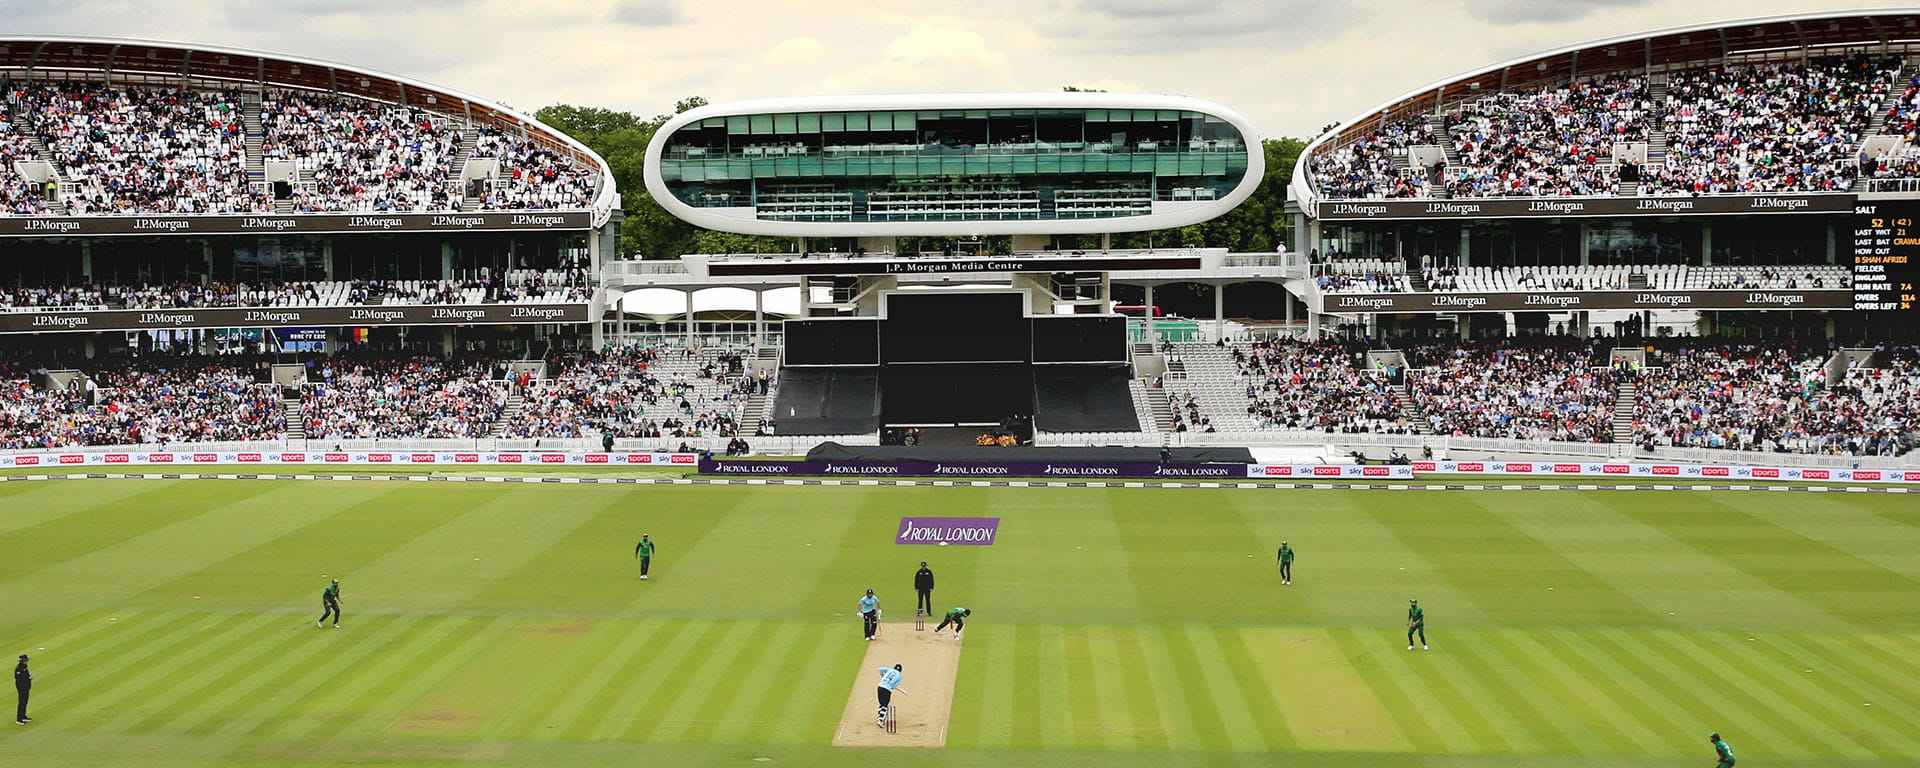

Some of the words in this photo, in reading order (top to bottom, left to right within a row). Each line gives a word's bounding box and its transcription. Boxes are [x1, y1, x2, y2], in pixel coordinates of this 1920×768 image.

[1529, 202, 1583, 213] J.P.Morgan
[1637, 200, 1693, 212] J.P.Morgan
[1751, 198, 1808, 210] J.P.Morgan
[1333, 205, 1386, 216] J.P.Morgan
[1426, 203, 1480, 215] J.P.Morgan
[1855, 206, 1876, 214] SALT
[134, 219, 189, 231] J.P.Morgan
[241, 218, 296, 230] J.P.Morgan
[349, 217, 402, 229] J.P.Morgan
[431, 216, 484, 228] J.P.Morgan
[511, 215, 564, 227] J.P.Morgan
[1872, 219, 1884, 227] 52
[25, 220, 79, 232] J.P.Morgan
[886, 264, 903, 272] J.P.
[907, 264, 947, 272] Morgan
[952, 262, 984, 270] Media
[988, 262, 1023, 270] Centre
[1339, 297, 1393, 309] J.P.Morgan
[1432, 296, 1486, 308] J.P.Morgan
[1525, 295, 1580, 307] J.P.Morgan
[1635, 294, 1691, 306] J.P.Morgan
[1746, 294, 1803, 305] J.P.Morgan
[245, 312, 299, 323] J.P.Morgan
[350, 310, 403, 321] J.P.Morgan
[432, 309, 484, 320] J.P.Morgan
[511, 308, 564, 319] J.P.Morgan
[33, 316, 88, 328] J.P.Morgan
[139, 314, 194, 325] J.P.Morgan
[16, 456, 38, 465] sports
[92, 455, 103, 463] sky
[106, 454, 128, 463] sports
[150, 454, 172, 462] sports
[194, 454, 217, 462] sports
[225, 454, 236, 462] sky
[239, 454, 260, 462] sports
[283, 454, 303, 462] sports
[326, 454, 347, 462] sports
[369, 454, 391, 462] sports
[413, 454, 434, 462] sports
[457, 454, 478, 462] sports
[487, 455, 497, 463] sky
[499, 454, 521, 463] sports
[529, 455, 540, 463] sky
[542, 454, 564, 463] sports
[573, 455, 584, 463] sky
[616, 455, 627, 463] sky
[862, 466, 898, 474] LONDON
[942, 466, 969, 474] ROYAL
[971, 466, 1008, 474] LONDON
[1252, 467, 1263, 475] sky
[1301, 467, 1313, 475] sky
[1349, 468, 1361, 476] sky
[1364, 468, 1389, 476] sports
[1492, 464, 1504, 472] sky
[1507, 464, 1531, 472] sports
[1555, 464, 1580, 473] sports
[1639, 466, 1651, 474] sky
[1653, 466, 1678, 475] sports
[1688, 467, 1700, 475] sky
[1702, 468, 1728, 476] sports
[1788, 470, 1801, 478] sky
[1803, 470, 1829, 479] sports
[1839, 471, 1851, 480] sky
[1854, 472, 1880, 481] sports
[911, 528, 942, 540] ROYAL
[946, 528, 992, 541] LONDON
